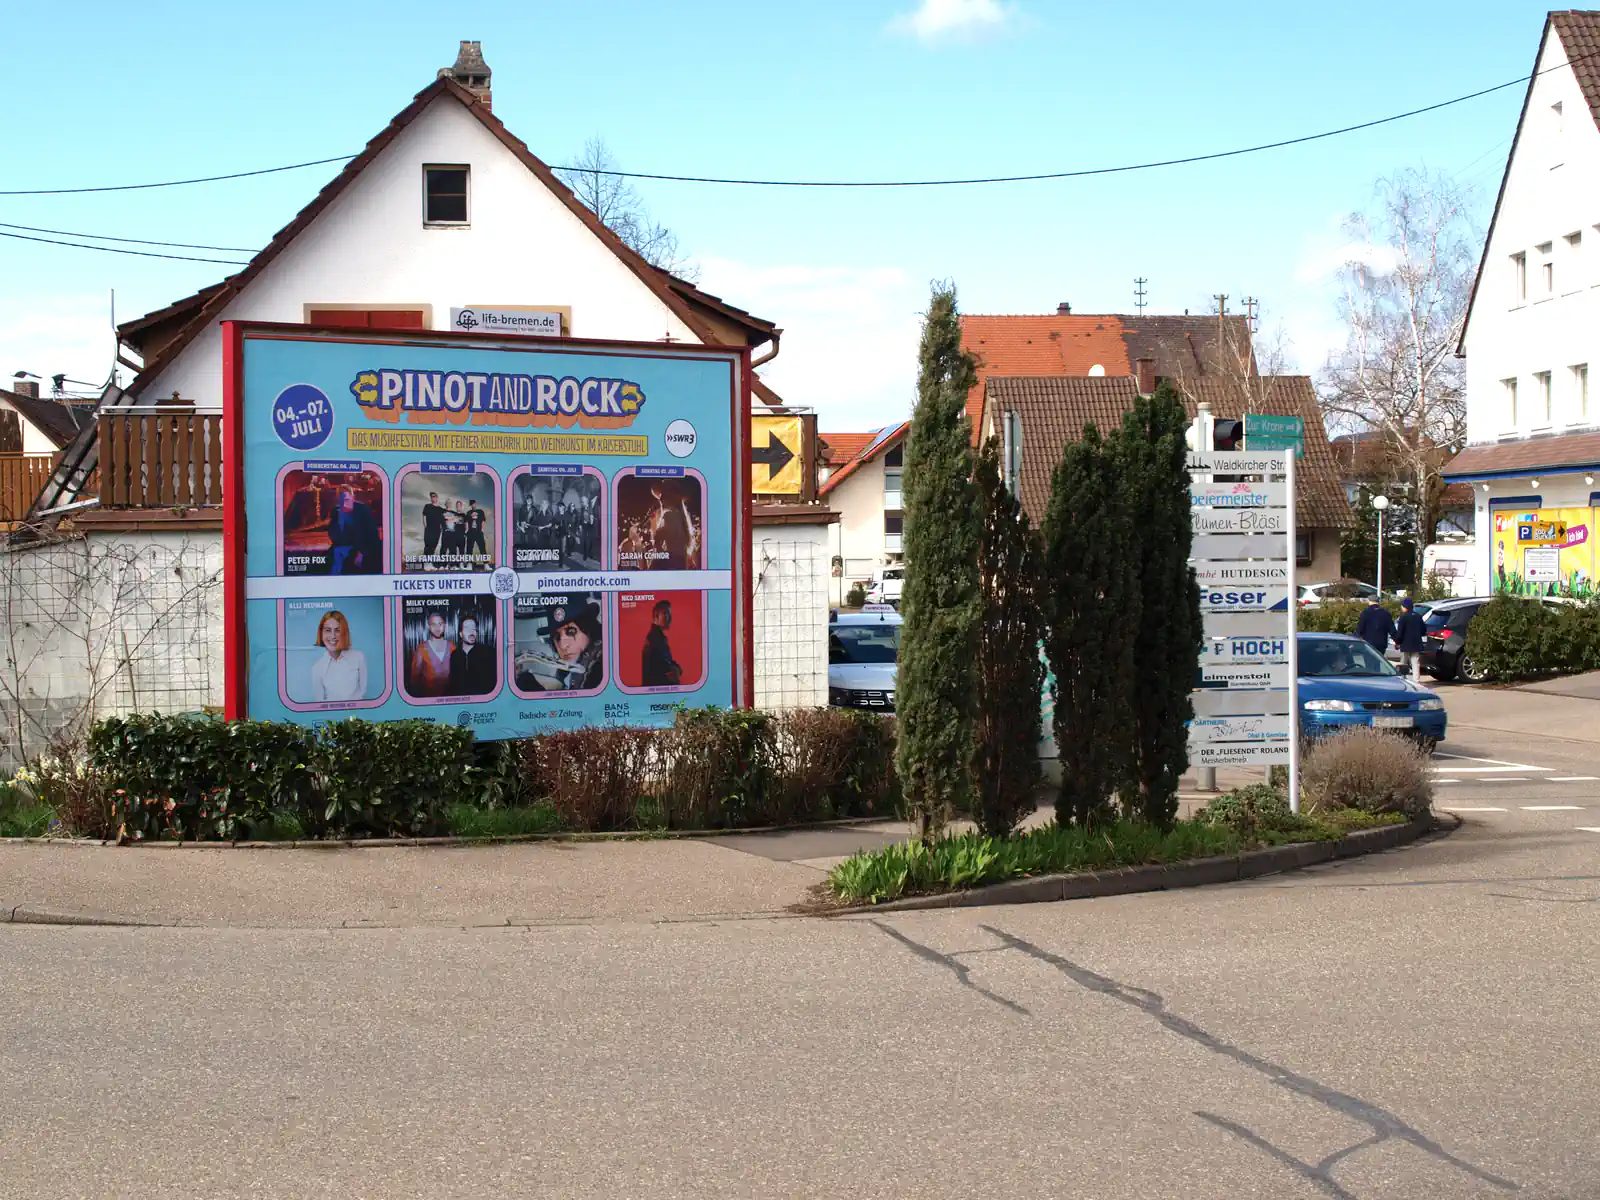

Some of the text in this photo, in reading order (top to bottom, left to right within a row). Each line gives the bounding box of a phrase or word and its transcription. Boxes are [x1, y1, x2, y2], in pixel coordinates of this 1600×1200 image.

[482, 313, 555, 327] lifa-bremen.de
[381, 372, 623, 414] PINOT AND ROCK
[291, 418, 323, 439] JULI
[1246, 418, 1284, 432] Zur Krone
[352, 432, 646, 454] DAS MUSIKFESTIVAL MIT FEINER KULINARIK UND WEINKUNST IM KAISERSTUHL
[673, 434, 695, 444] SWR3
[1213, 459, 1285, 471] Waldkircher Str.
[1521, 527, 1530, 539] P
[287, 556, 326, 565] PETER FOX
[405, 554, 492, 563] DIE FANTASTISCHEN VIER
[620, 551, 670, 560] SARAH CONNOR
[1221, 568, 1287, 578] HUTDESIGN
[393, 578, 472, 591] TICKETS UNTER
[537, 576, 630, 590] pinotandrock.com
[406, 599, 425, 607] MILKY
[517, 596, 568, 606] ALICE COOPER
[1232, 641, 1284, 655] HOCH
[604, 703, 629, 711] BANS
[519, 709, 583, 720] Badische Zeitung
[604, 710, 630, 718] BACH
